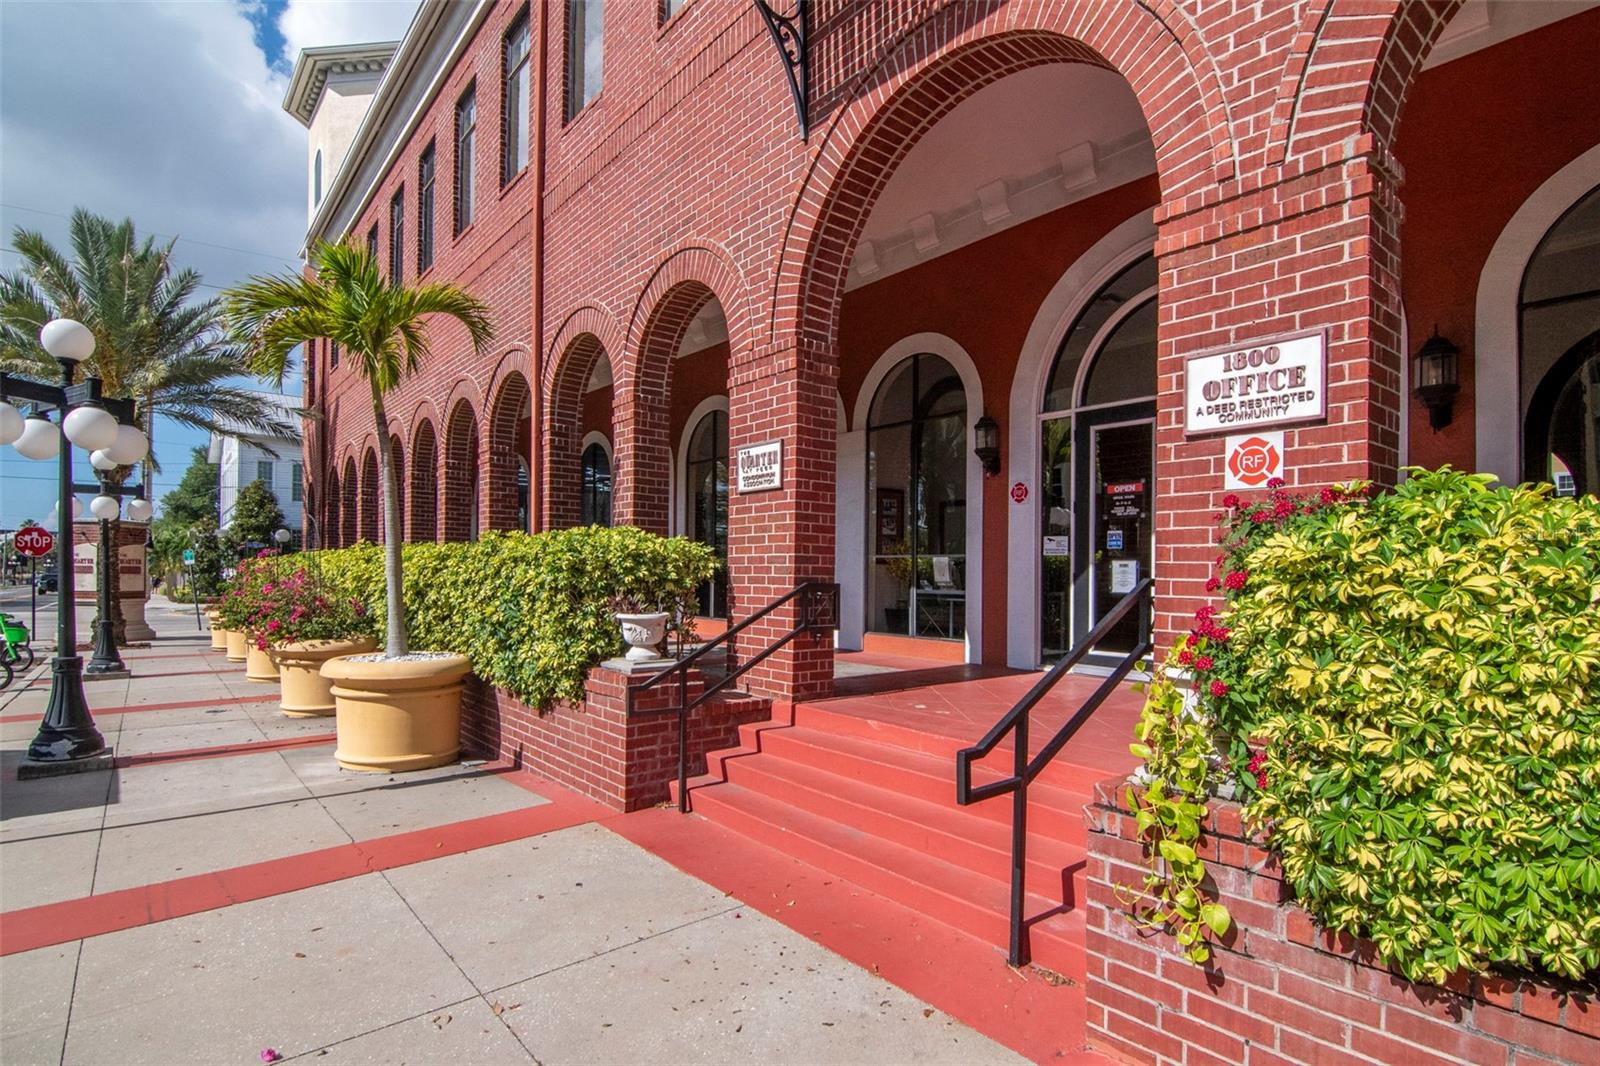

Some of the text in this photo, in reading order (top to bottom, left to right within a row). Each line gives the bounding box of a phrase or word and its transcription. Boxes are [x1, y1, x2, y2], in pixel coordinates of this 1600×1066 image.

[1223, 346, 1280, 373] 1800
[1202, 365, 1306, 401] OFFICE
[1196, 390, 1315, 417] A DEED RESTRICTED
[1218, 405, 1289, 424] COMMUNITY
[741, 451, 778, 473] QUARTER
[1242, 454, 1264, 469] RF
[1114, 484, 1136, 493] OPEN
[16, 535, 51, 548] STOP
